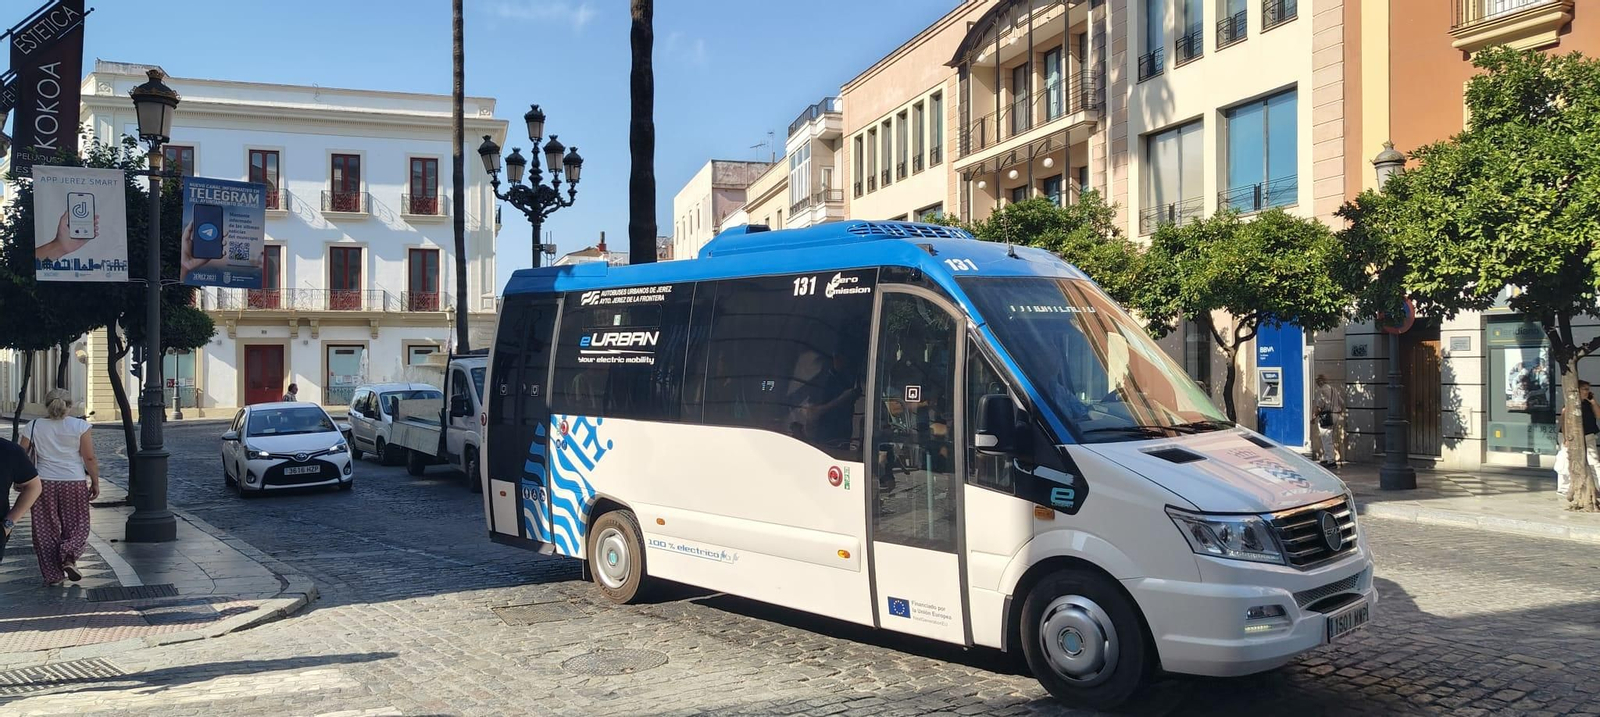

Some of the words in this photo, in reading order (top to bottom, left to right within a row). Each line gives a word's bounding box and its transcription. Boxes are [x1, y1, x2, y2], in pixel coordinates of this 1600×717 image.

[34, 62, 61, 150] KOKOA
[61, 177, 87, 185] JEREZ
[189, 187, 260, 204] TELEGRAM
[944, 258, 979, 272] 131
[628, 286, 649, 295] URBANOS
[656, 285, 672, 293] JEREZ
[793, 276, 817, 297] 131
[626, 356, 655, 366] mobility
[648, 538, 667, 548] 100
[912, 600, 938, 610] Financiado
[932, 610, 952, 620] Europea
